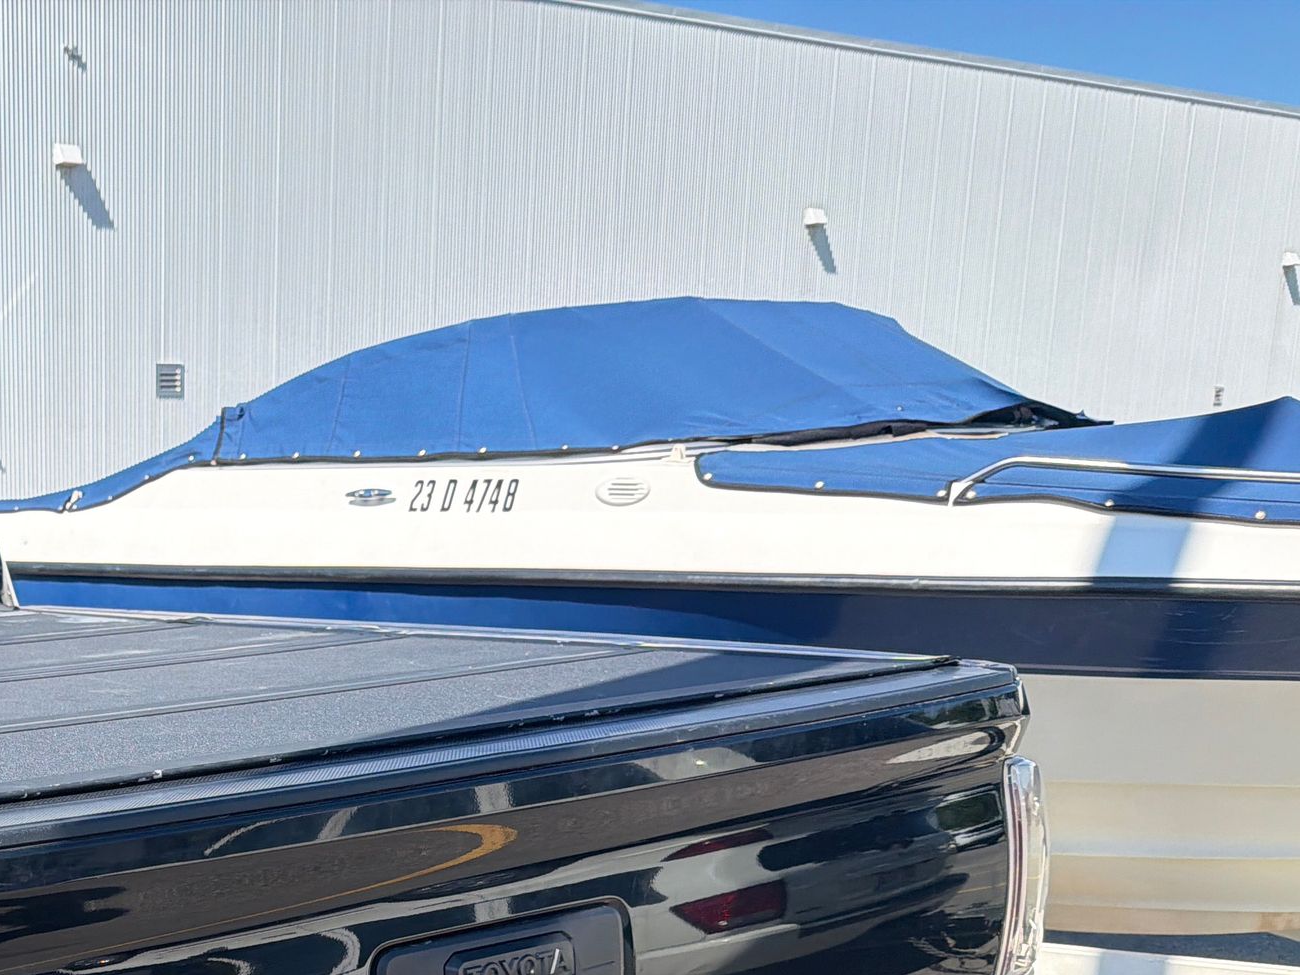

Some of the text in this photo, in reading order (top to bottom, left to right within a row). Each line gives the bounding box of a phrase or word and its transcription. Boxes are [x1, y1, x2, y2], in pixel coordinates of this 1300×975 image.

[408, 478, 519, 513] 23 D 4748
